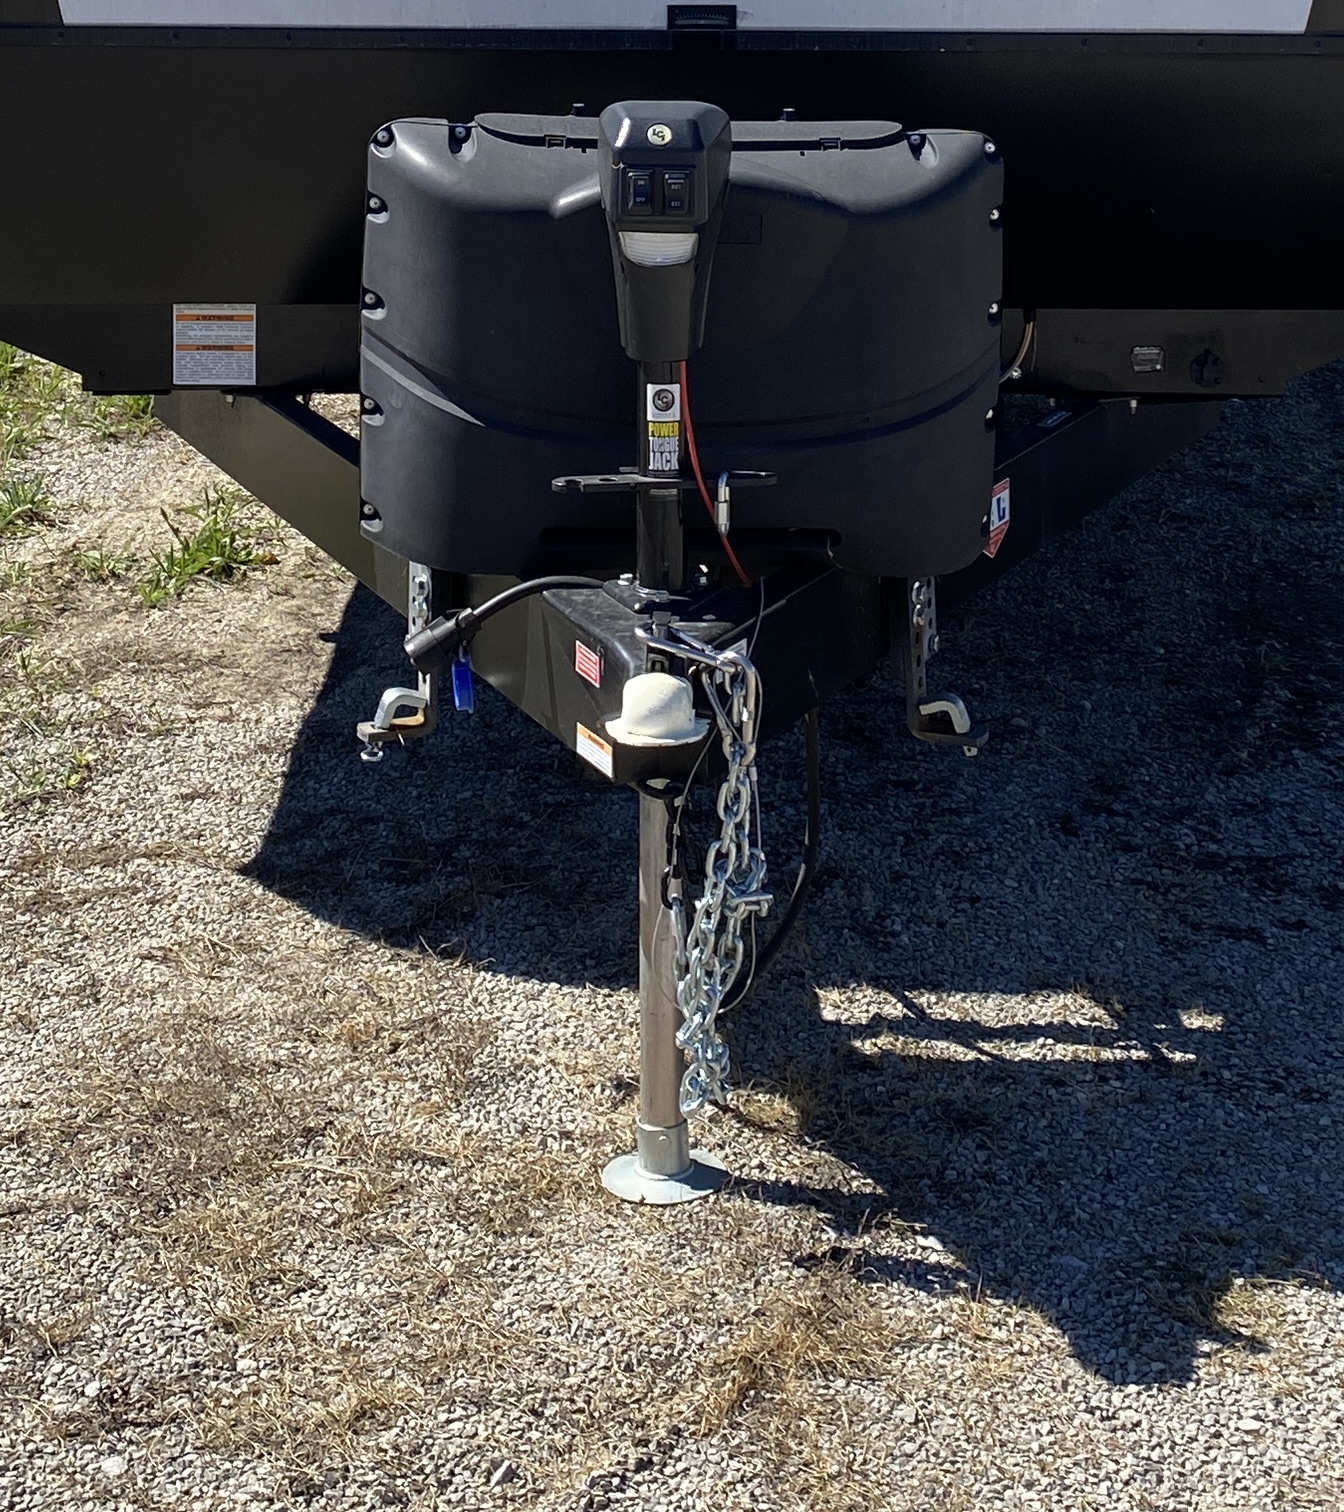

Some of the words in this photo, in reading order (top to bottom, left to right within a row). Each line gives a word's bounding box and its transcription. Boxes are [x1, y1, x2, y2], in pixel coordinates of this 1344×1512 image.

[648, 422, 679, 437] POWER
[649, 437, 679, 452] TONGUE
[648, 452, 679, 470] JACK
